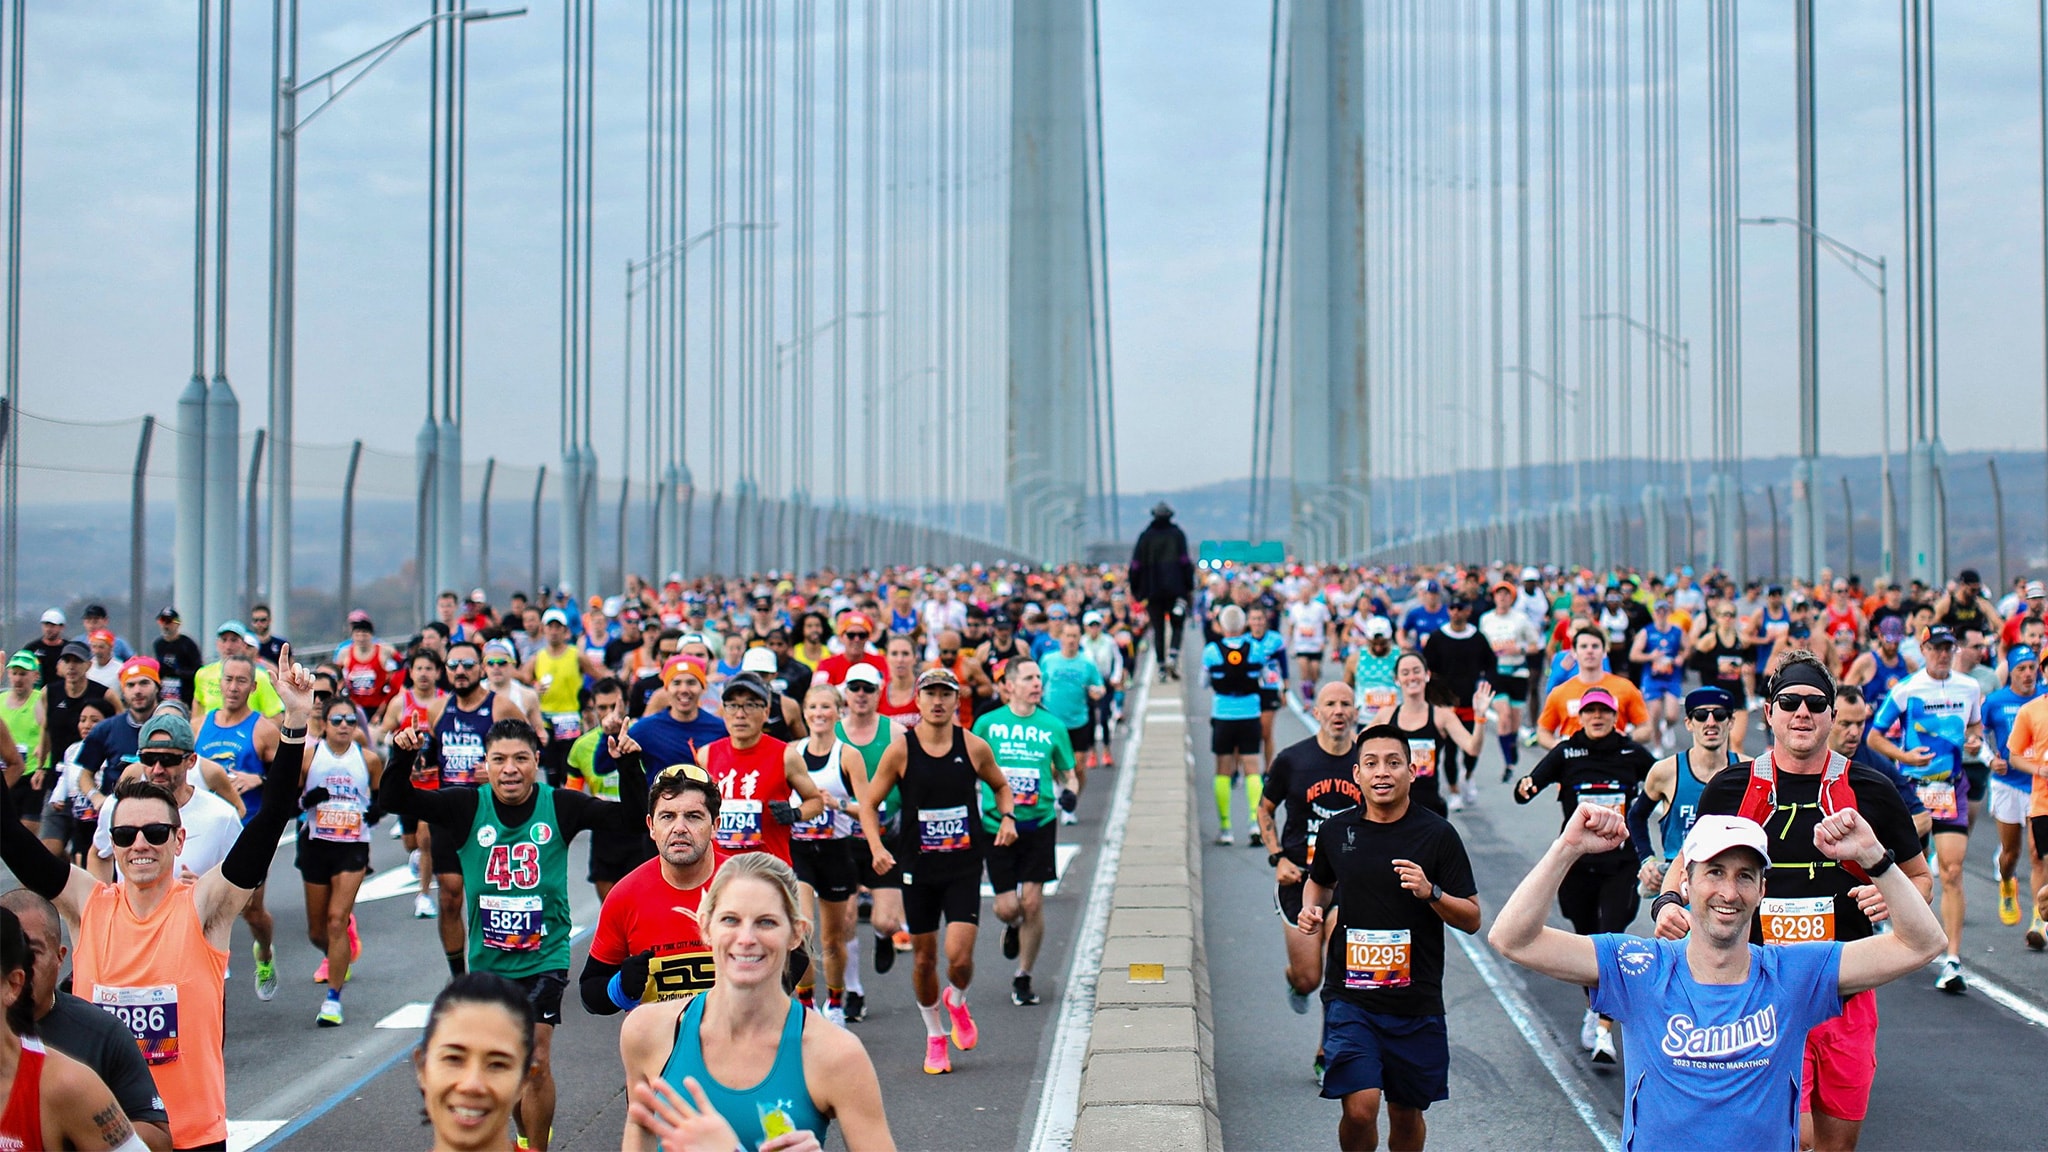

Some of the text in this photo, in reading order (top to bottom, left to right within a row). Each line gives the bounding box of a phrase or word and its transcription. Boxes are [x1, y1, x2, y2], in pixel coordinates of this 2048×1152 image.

[989, 723, 1052, 745] MARK
[1306, 778, 1361, 805] NEW YORK
[926, 819, 964, 836] 5402
[485, 842, 540, 891] 43
[490, 910, 531, 930] 5821
[1771, 916, 1825, 939] 6298
[1350, 945, 1406, 965] 10295
[1661, 1003, 1778, 1057] Sammy
[1692, 1061, 1707, 1069] TCS
[1709, 1062, 1725, 1070] NYC
[1727, 1058, 1770, 1069] MARATHON
